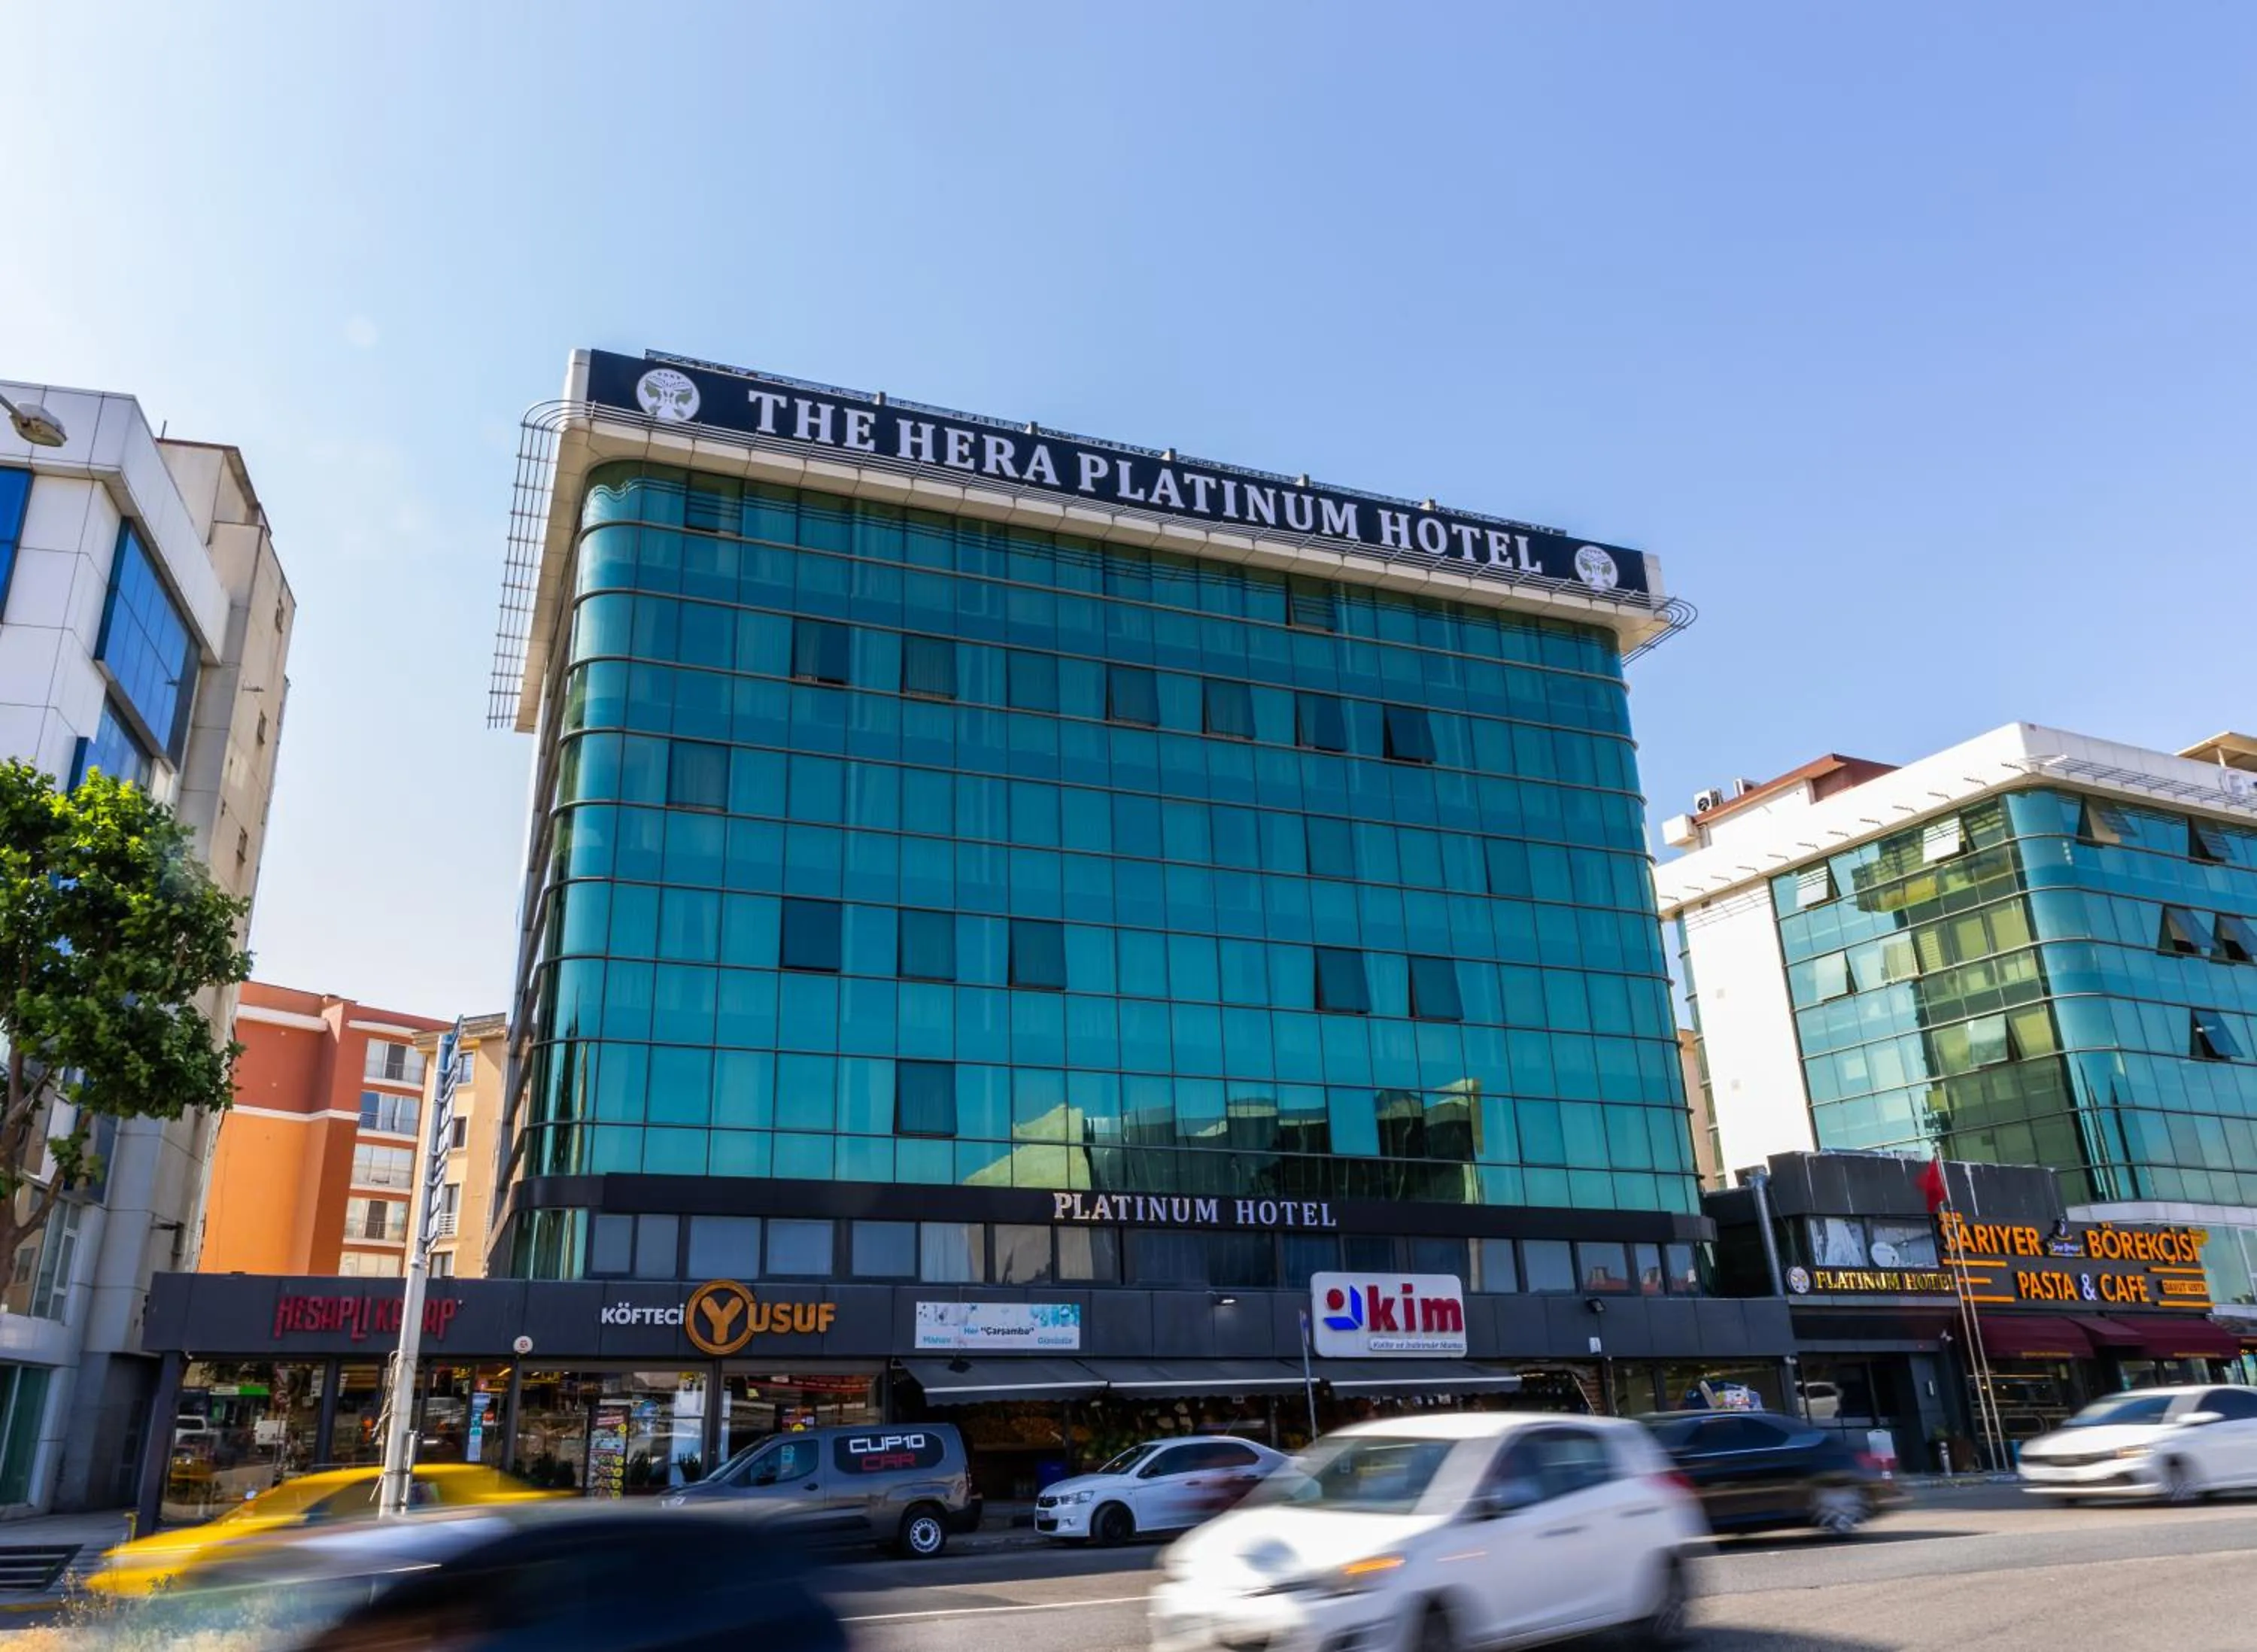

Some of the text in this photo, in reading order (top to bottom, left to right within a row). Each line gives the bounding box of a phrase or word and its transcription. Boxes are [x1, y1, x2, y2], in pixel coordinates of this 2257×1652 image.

[748, 390, 1542, 573] THE HERA PLATINUM HOTEL
[1053, 1192, 1336, 1227] PLATINUM HOTEL
[1940, 1220, 2200, 1265] SARIYER BÖREKÇİSİ
[1815, 1271, 1901, 1290] PLATINUM
[2017, 1270, 2150, 1303] PASTA & CAFE
[375, 1297, 456, 1339] KAAP
[601, 1295, 837, 1344] KÖFTECİ YUSUF
[1366, 1283, 1463, 1333] kim
[849, 1435, 925, 1453] CUP10
[861, 1453, 915, 1471] CAR
